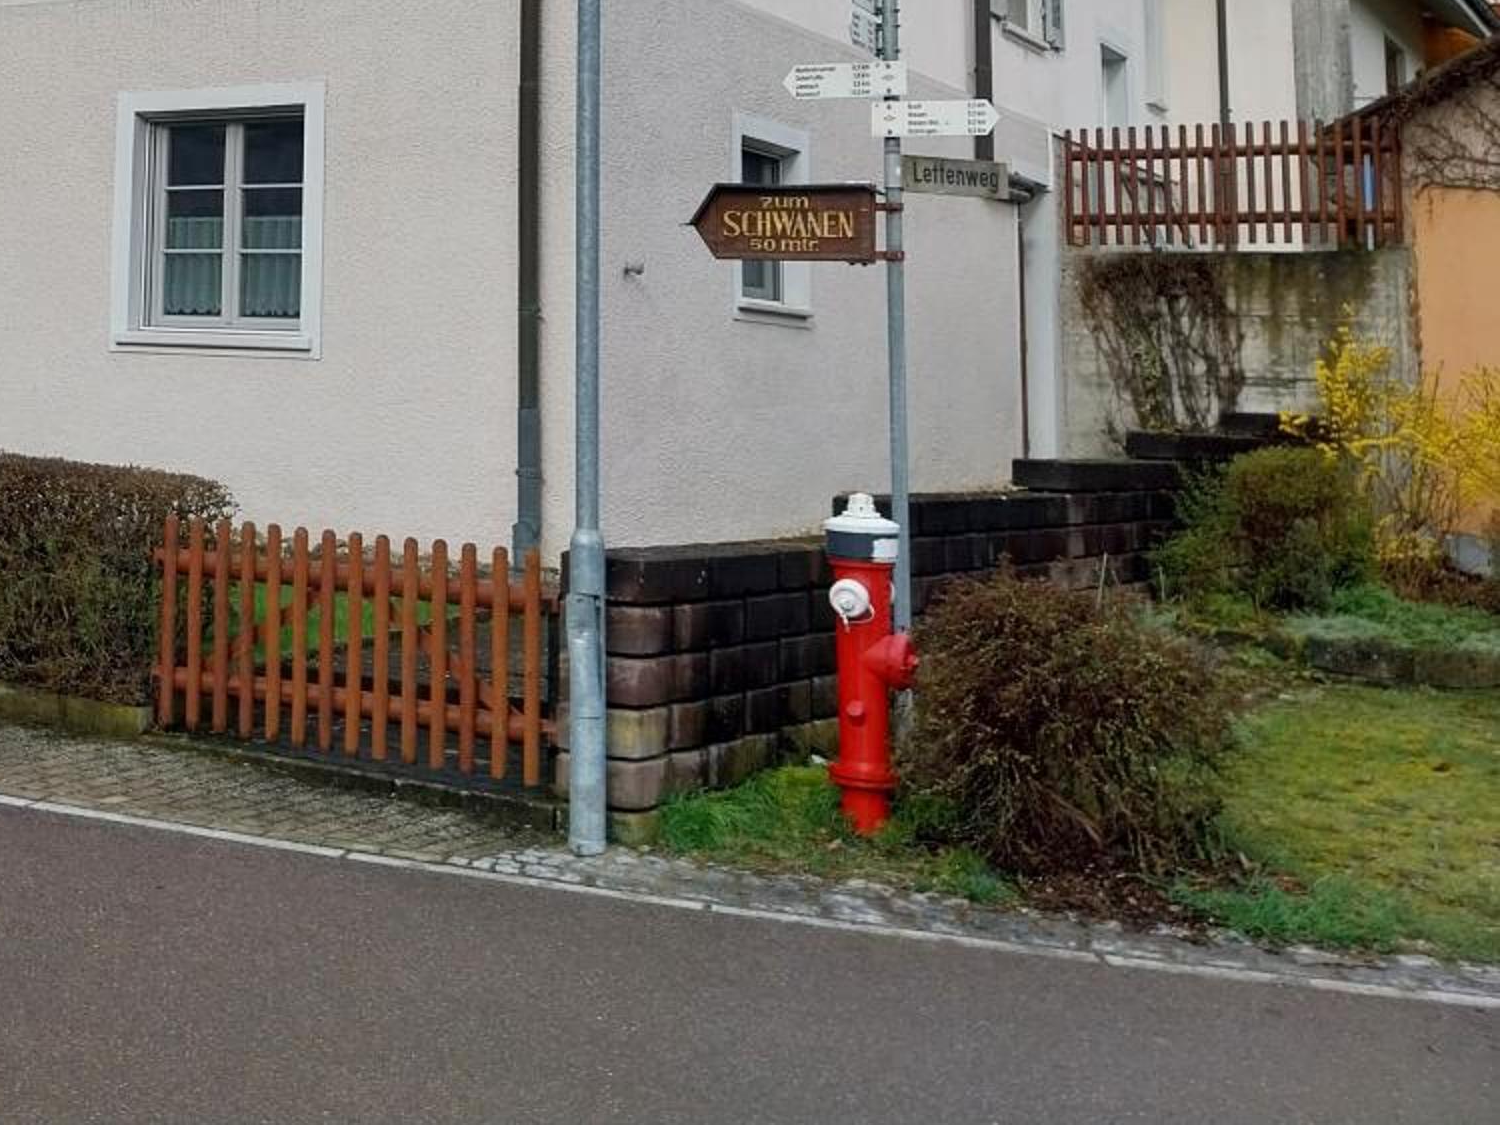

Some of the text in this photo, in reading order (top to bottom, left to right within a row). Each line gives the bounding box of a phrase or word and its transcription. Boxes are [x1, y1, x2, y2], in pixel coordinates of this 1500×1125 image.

[912, 161, 998, 189] Lettenweg
[723, 210, 854, 239] SCHWANEN
[750, 238, 776, 252] 50
